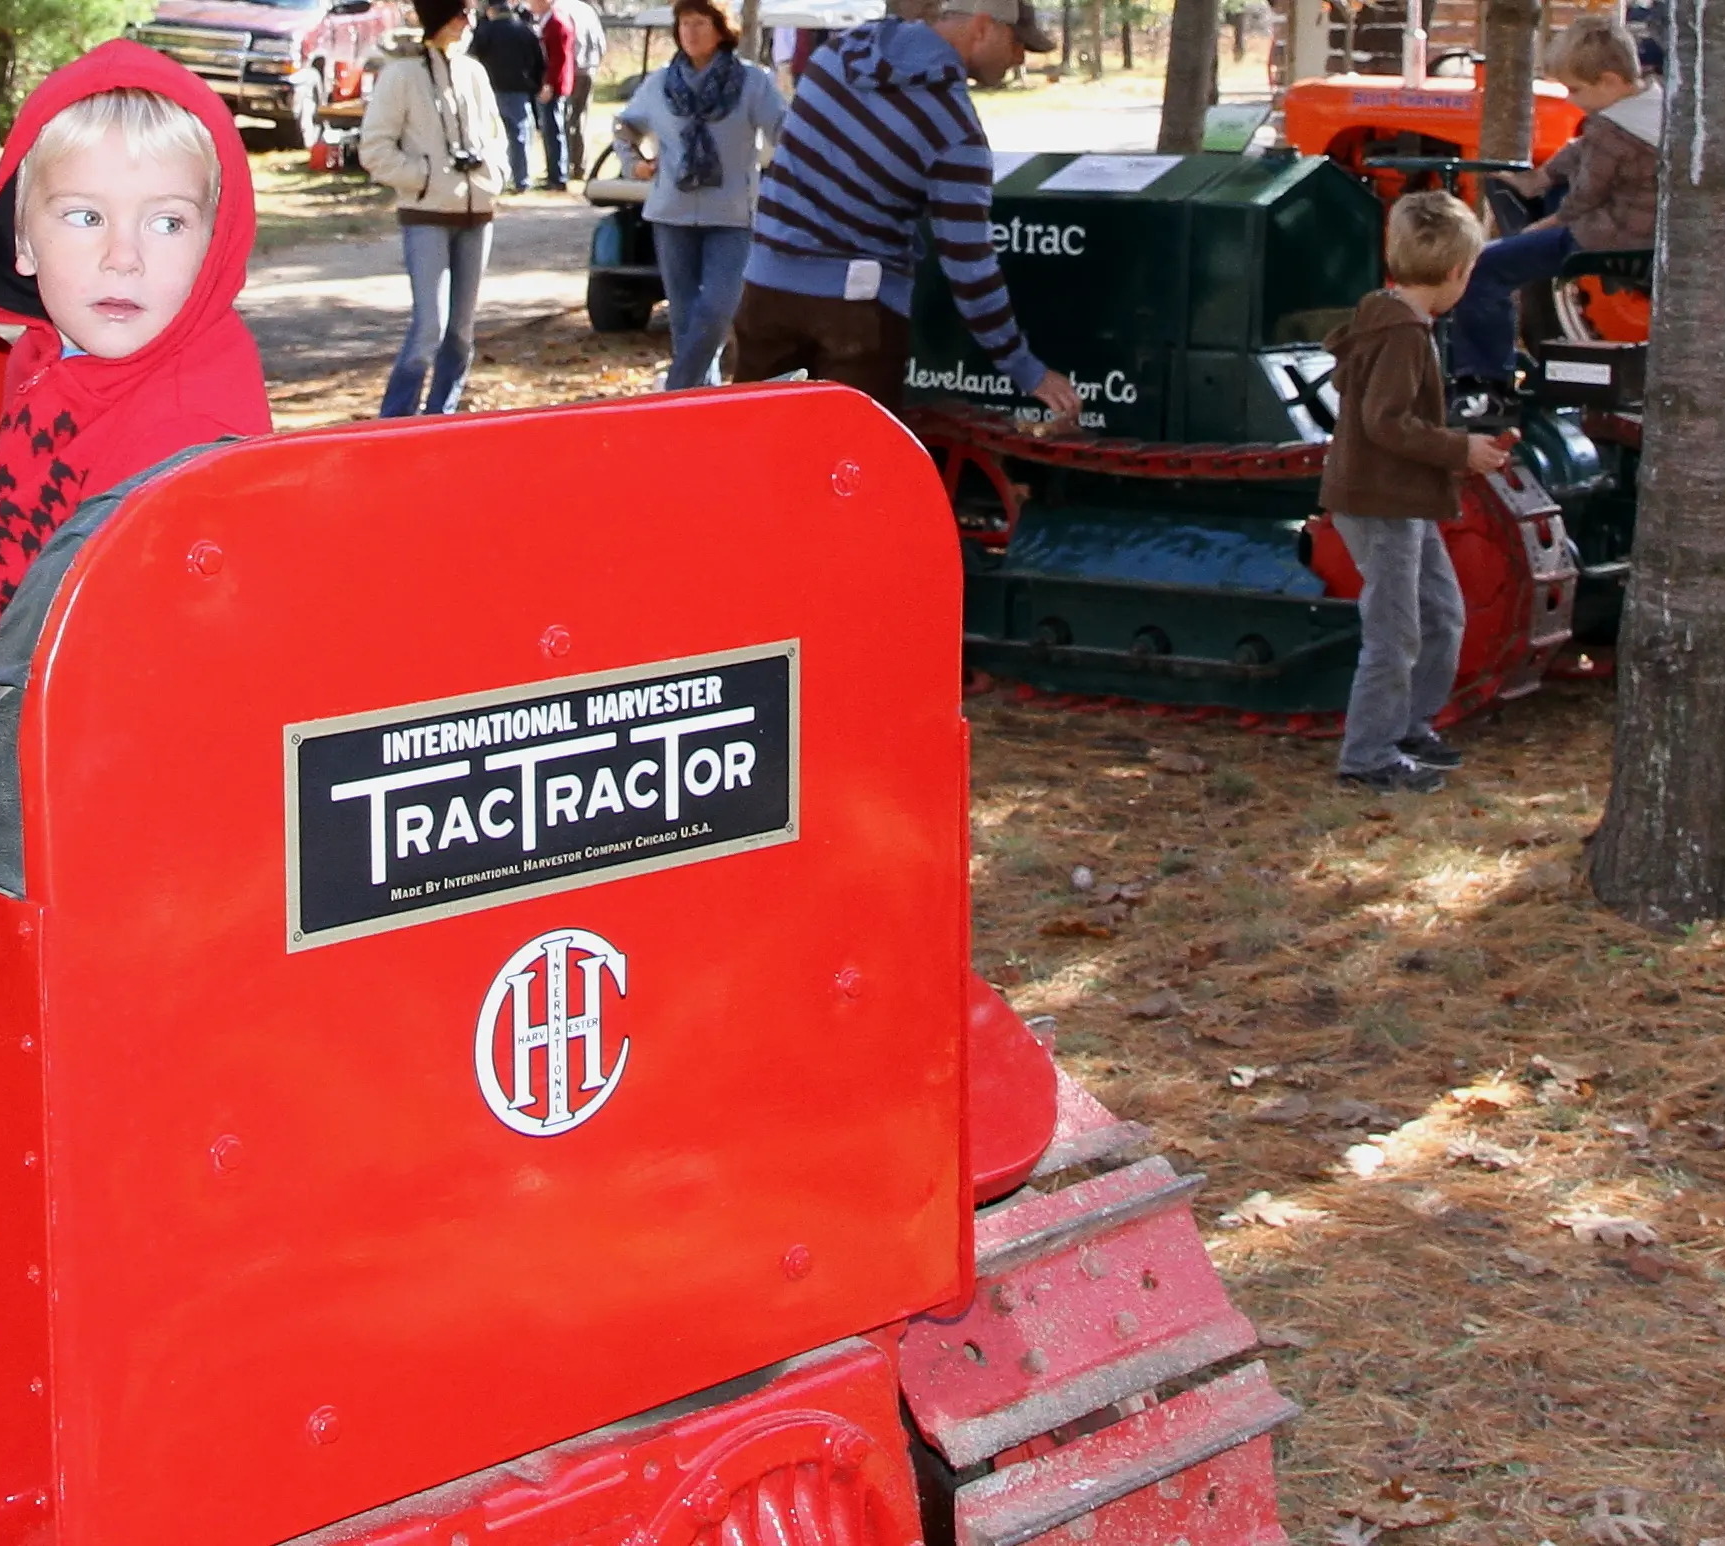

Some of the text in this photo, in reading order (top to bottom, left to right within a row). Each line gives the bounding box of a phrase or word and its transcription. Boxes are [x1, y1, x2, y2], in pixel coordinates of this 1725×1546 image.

[992, 216, 1086, 256] etrac
[1105, 370, 1137, 403] Co
[1078, 412, 1106, 428] USA
[382, 675, 722, 765] INTERNATIONAL HARVESTER
[680, 822, 713, 838] U.S.A.
[552, 948, 563, 1115] INTERNATIONAL
